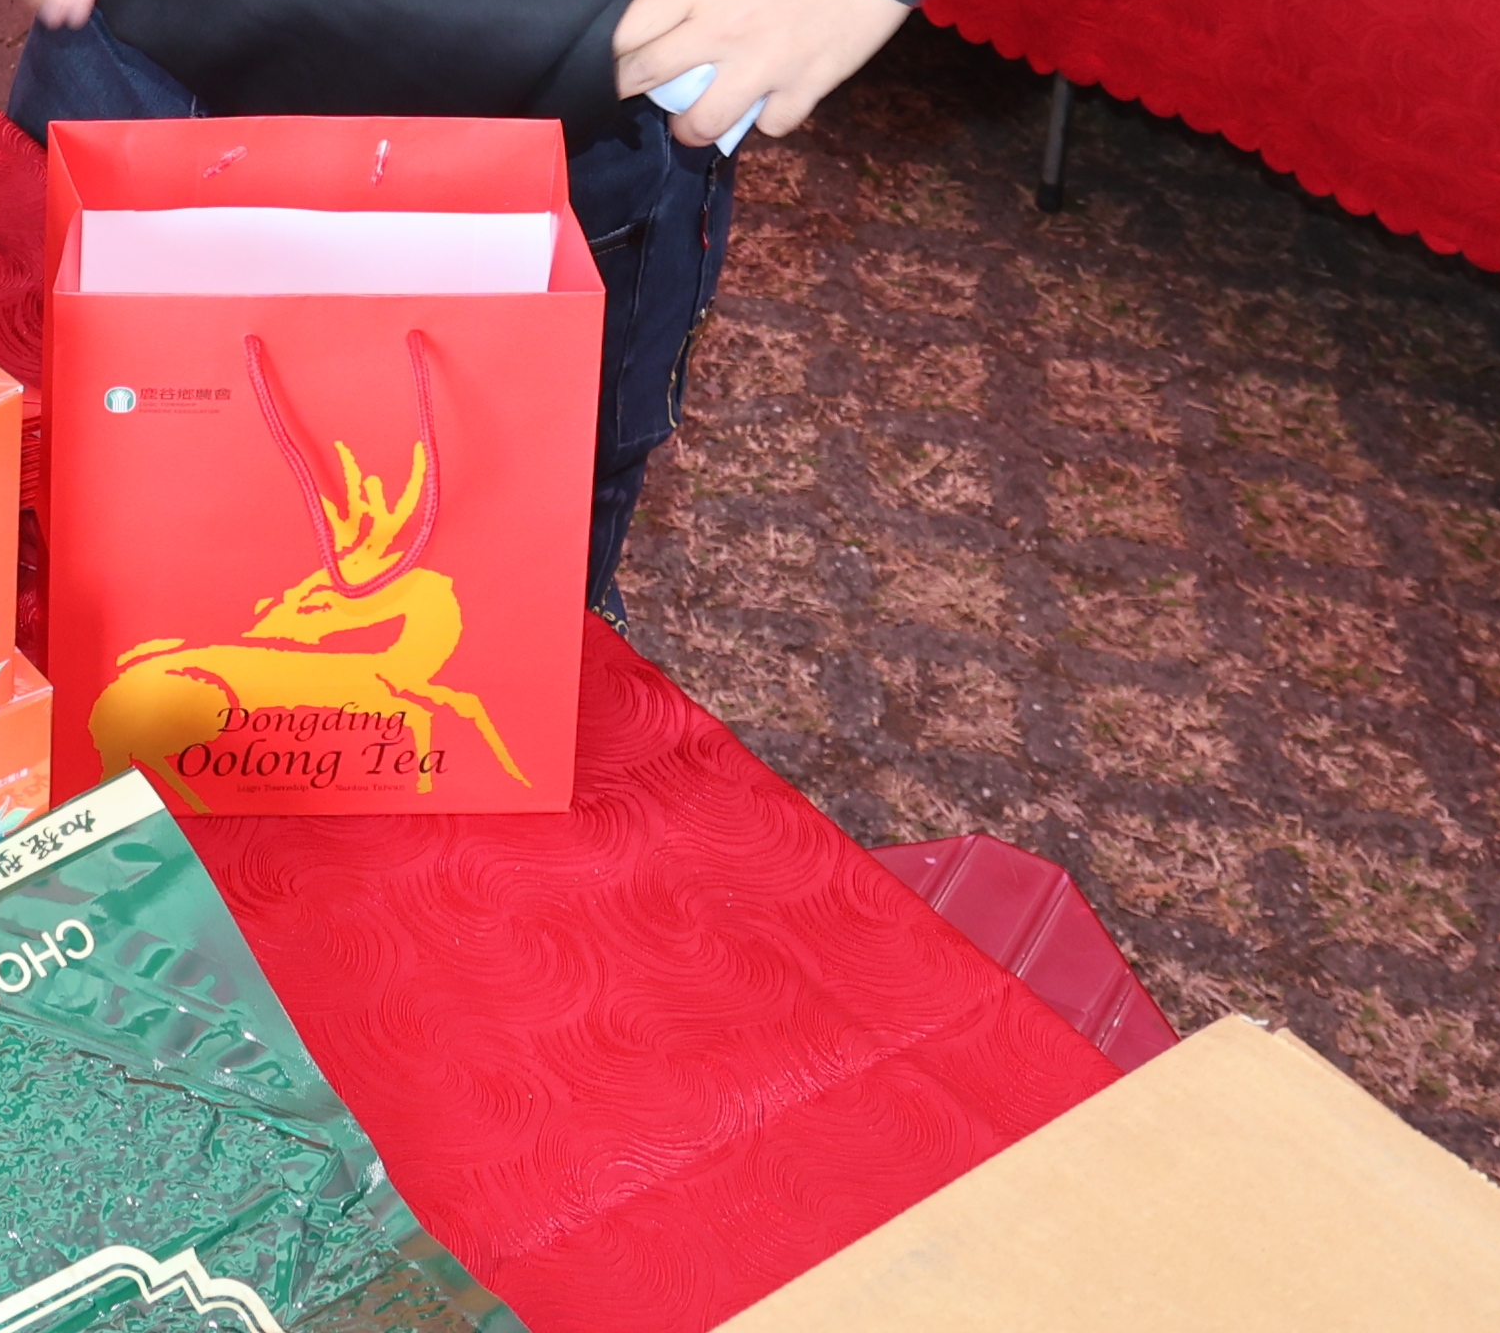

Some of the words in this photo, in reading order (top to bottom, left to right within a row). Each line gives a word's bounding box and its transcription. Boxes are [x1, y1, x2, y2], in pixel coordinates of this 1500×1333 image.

[139, 387, 232, 401] 鹿谷鄉農會
[217, 701, 407, 742] Dongding
[177, 738, 342, 789] Oolong
[361, 741, 449, 775] Tea
